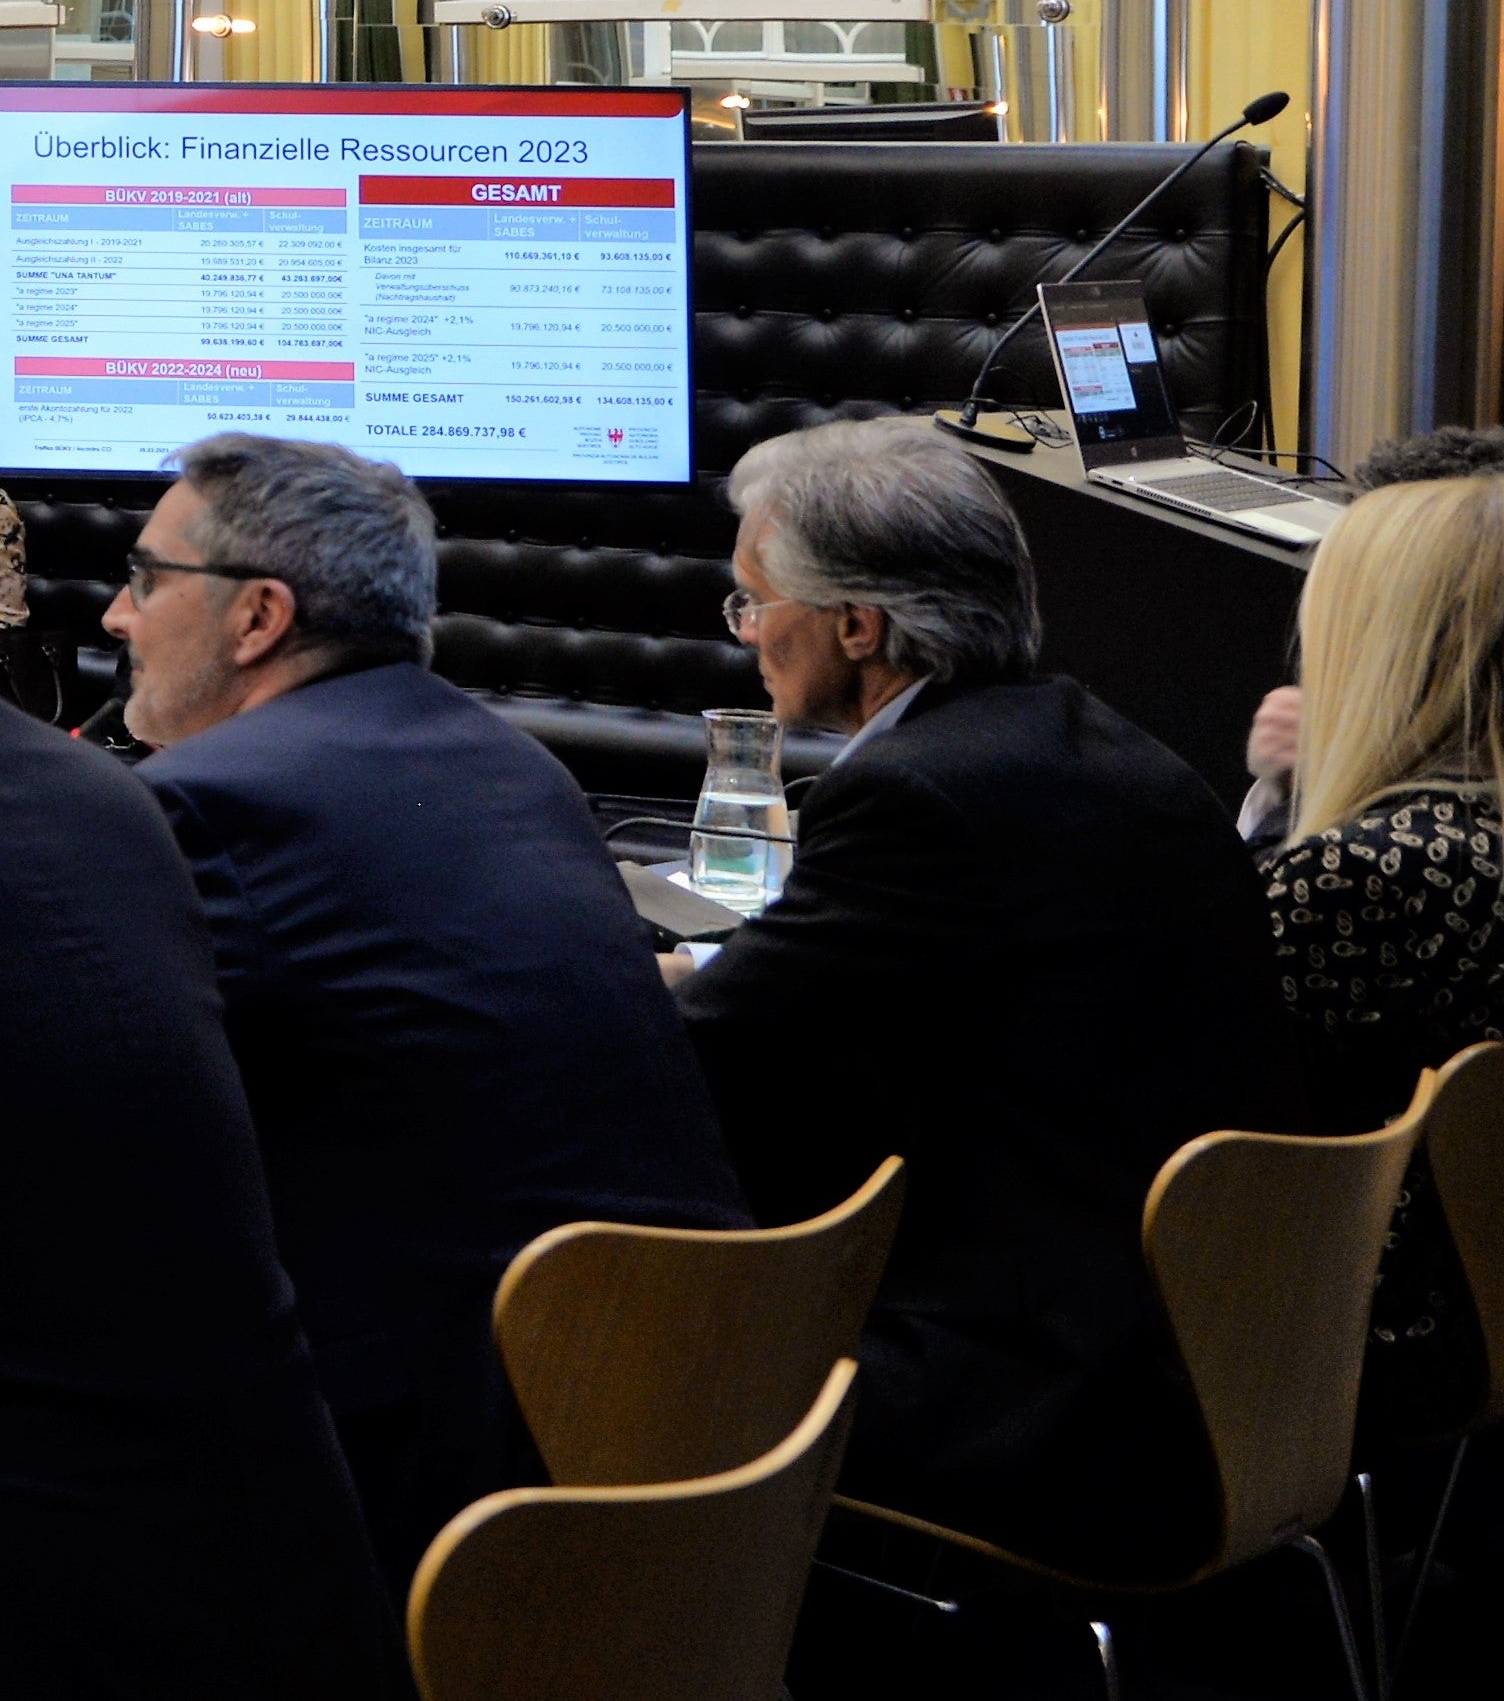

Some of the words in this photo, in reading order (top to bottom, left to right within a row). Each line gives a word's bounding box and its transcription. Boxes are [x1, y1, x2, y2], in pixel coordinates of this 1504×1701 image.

[34, 131, 169, 160] Überblick:
[182, 136, 330, 161] Finanzielle
[341, 138, 508, 163] Ressourcen
[518, 140, 588, 164] 2023
[105, 187, 147, 203] BÜKV
[150, 190, 221, 205] 2019-2021
[224, 191, 252, 206] (alt)
[471, 183, 562, 202] GESAMT
[16, 213, 69, 223] ZEITRAUM
[364, 217, 433, 229] ZEITRAUM
[585, 214, 622, 225] Schul-
[178, 221, 214, 231] SABES
[494, 226, 535, 238] SABES
[585, 227, 649, 241] verwaltung
[101, 238, 142, 246] 2019-2021
[364, 244, 396, 253] Kosten
[398, 244, 447, 254] insgesamt
[103, 256, 123, 264] 2022
[364, 255, 392, 265] Bilanz
[395, 256, 419, 265] 2023
[16, 271, 48, 279] SUMME
[376, 316, 409, 325] regime
[364, 327, 432, 338] NIC-Ausgleich
[16, 335, 48, 343] SUMME
[51, 335, 89, 343] GESAMT
[377, 354, 409, 364] regime
[105, 359, 148, 375] BÜKV
[151, 363, 222, 377] 2022-2024
[225, 364, 262, 379] (neu)
[365, 365, 432, 376] NIC-Ausgleich
[19, 385, 73, 395] ZEITRAUM
[183, 395, 220, 404] SABES
[365, 392, 409, 403] SUMME
[412, 393, 464, 403] GESAMT
[113, 406, 133, 414] 2022
[366, 424, 418, 436] TOTALE
[421, 425, 515, 438] 284.869.737,98
[518, 428, 527, 438] €
